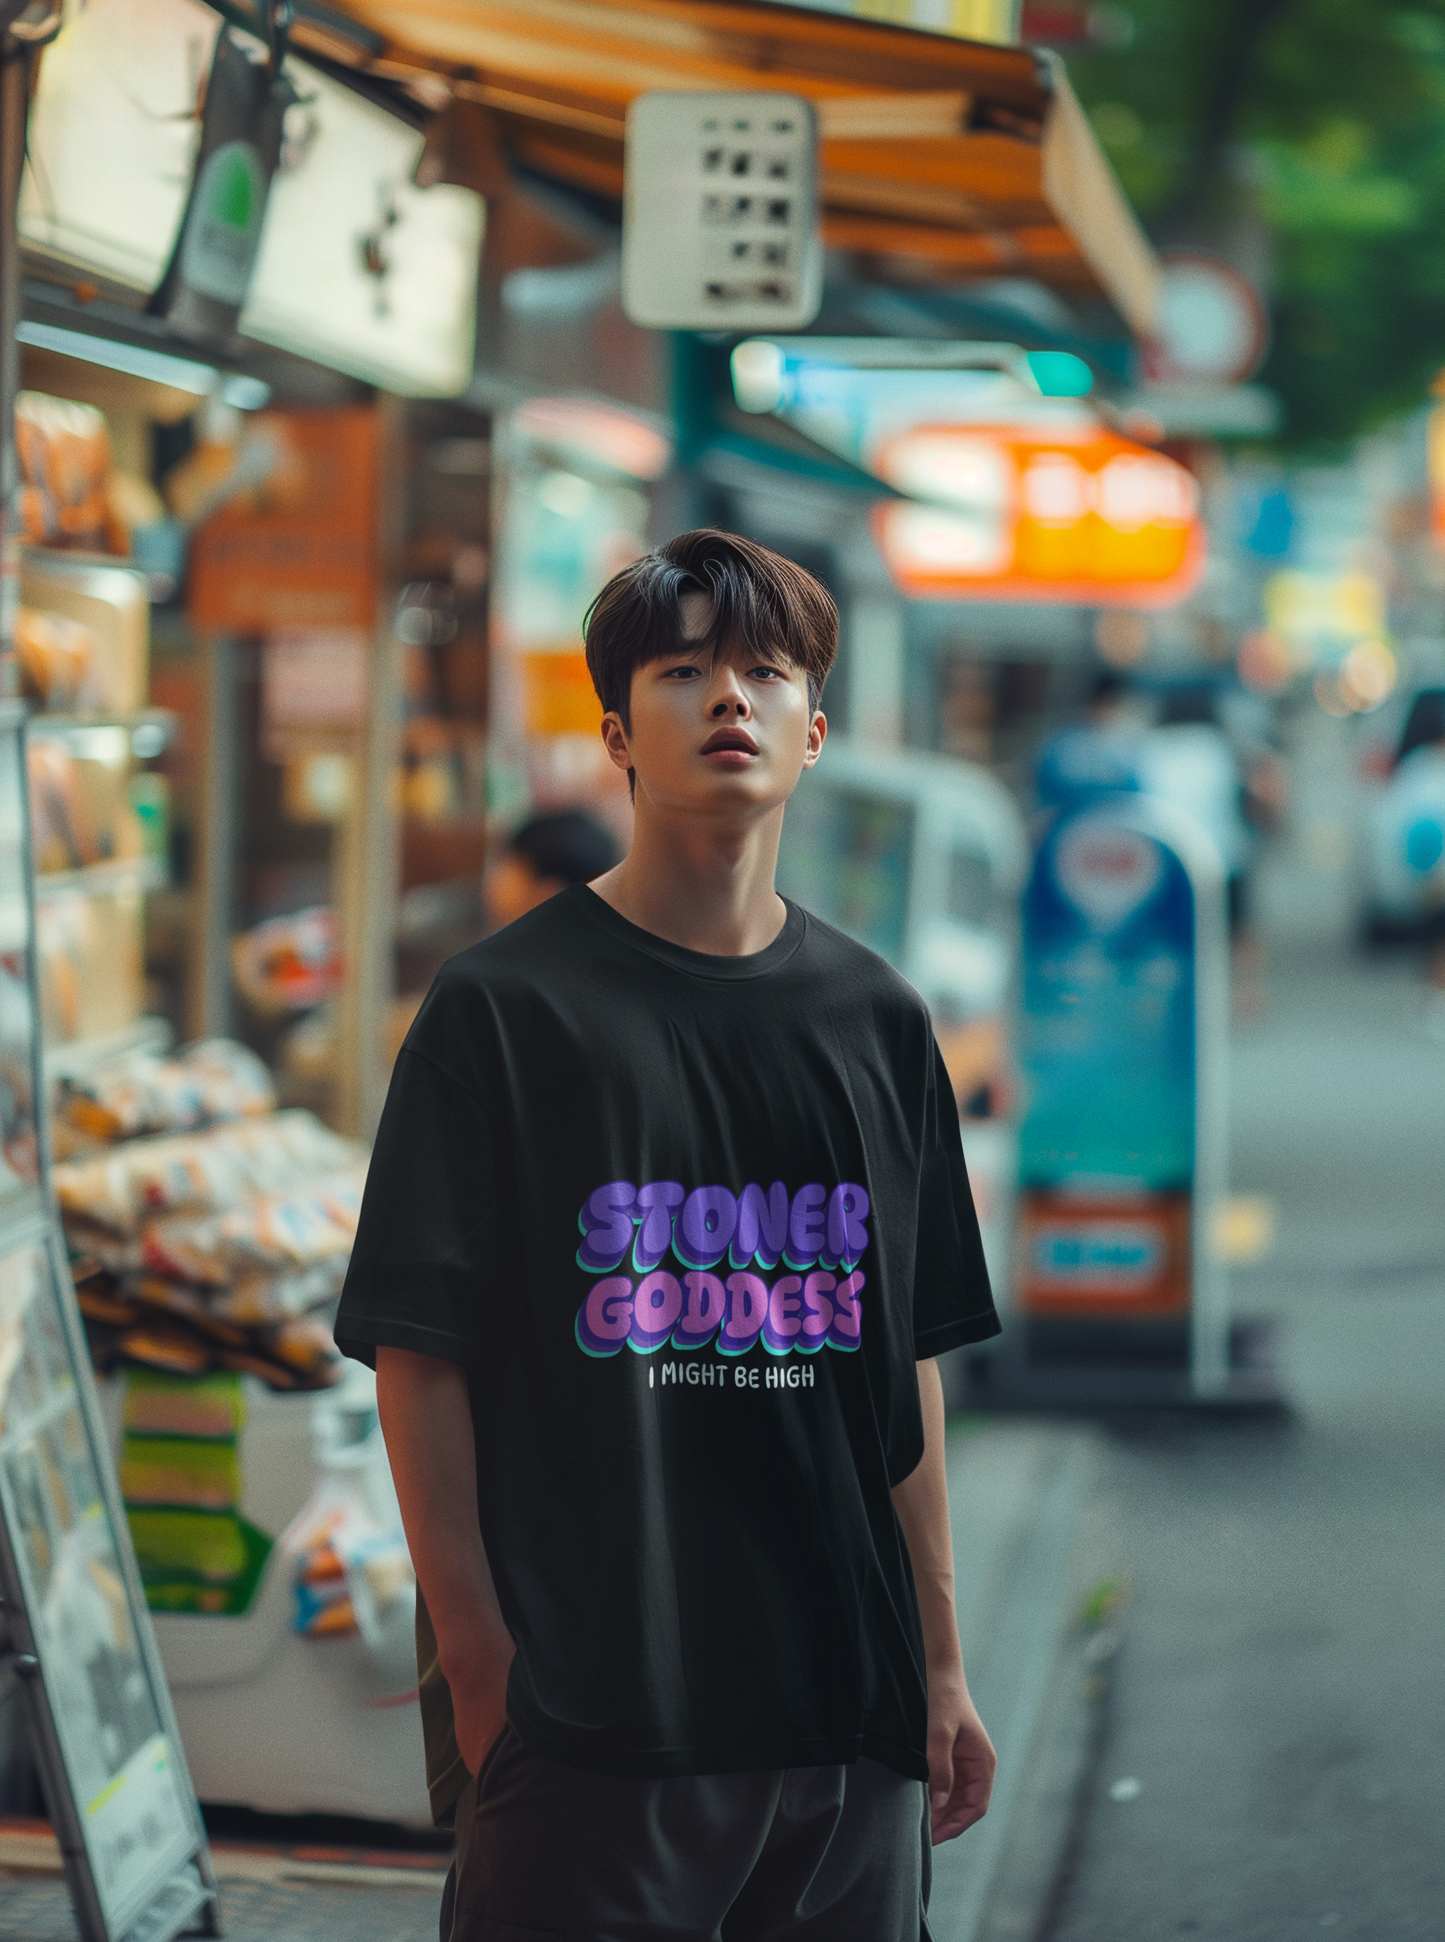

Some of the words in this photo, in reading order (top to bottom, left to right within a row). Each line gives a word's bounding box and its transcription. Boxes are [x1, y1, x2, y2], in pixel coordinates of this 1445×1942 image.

[576, 1180, 869, 1273] STONER
[575, 1269, 866, 1358] GODDESS
[649, 1366, 654, 1388] I
[661, 1361, 728, 1386] MIGHT
[734, 1365, 760, 1388] BE
[765, 1364, 815, 1389] HIGH
